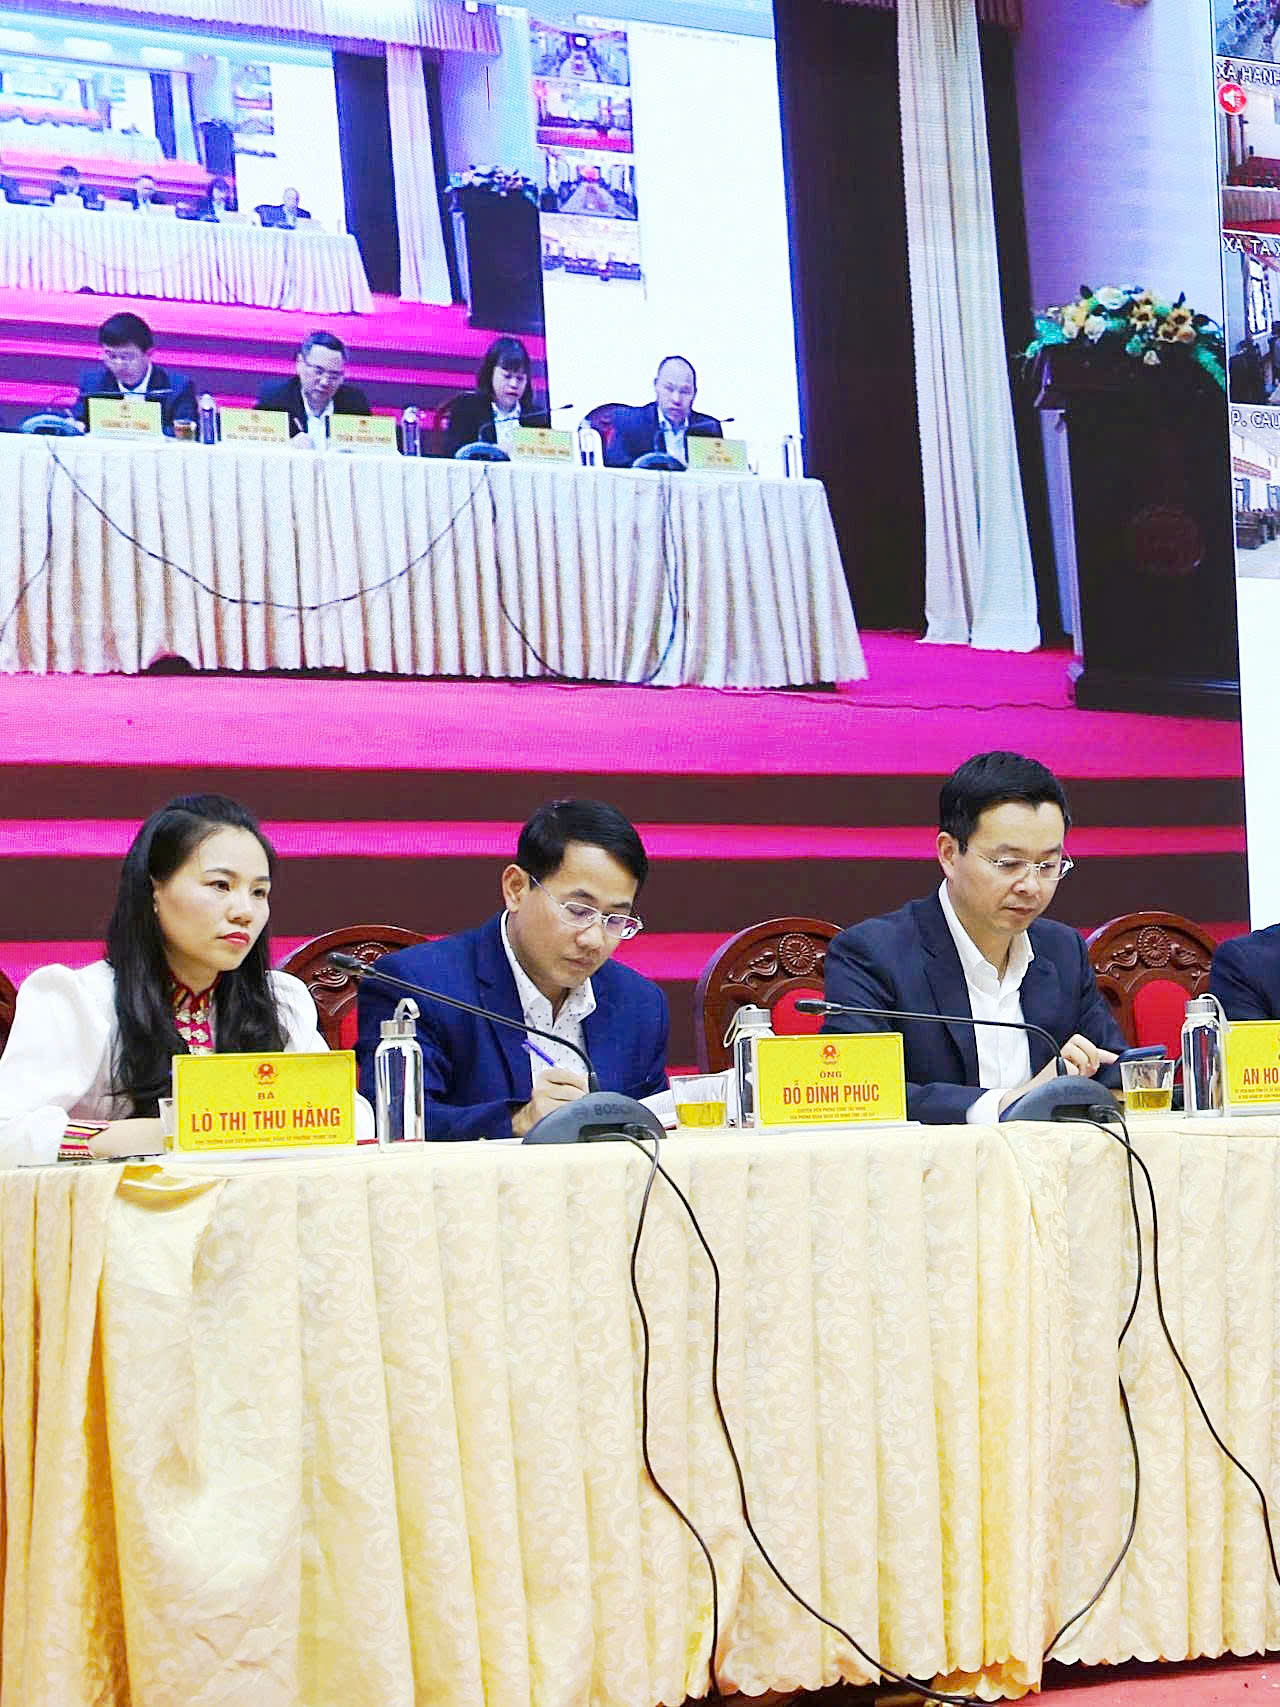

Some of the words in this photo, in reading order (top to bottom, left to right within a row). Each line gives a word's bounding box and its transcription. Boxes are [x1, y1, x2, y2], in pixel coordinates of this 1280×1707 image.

[1231, 409, 1247, 427] P.
[1243, 1067, 1260, 1085] AN
[783, 1080, 801, 1104] ĐỖ
[806, 1082, 839, 1104] ĐÌNH
[843, 1080, 880, 1103] PHÚC
[192, 1108, 213, 1133] LÒ
[219, 1111, 247, 1135] THỊ
[253, 1110, 287, 1130] THU
[293, 1101, 341, 1129] HẰNG
